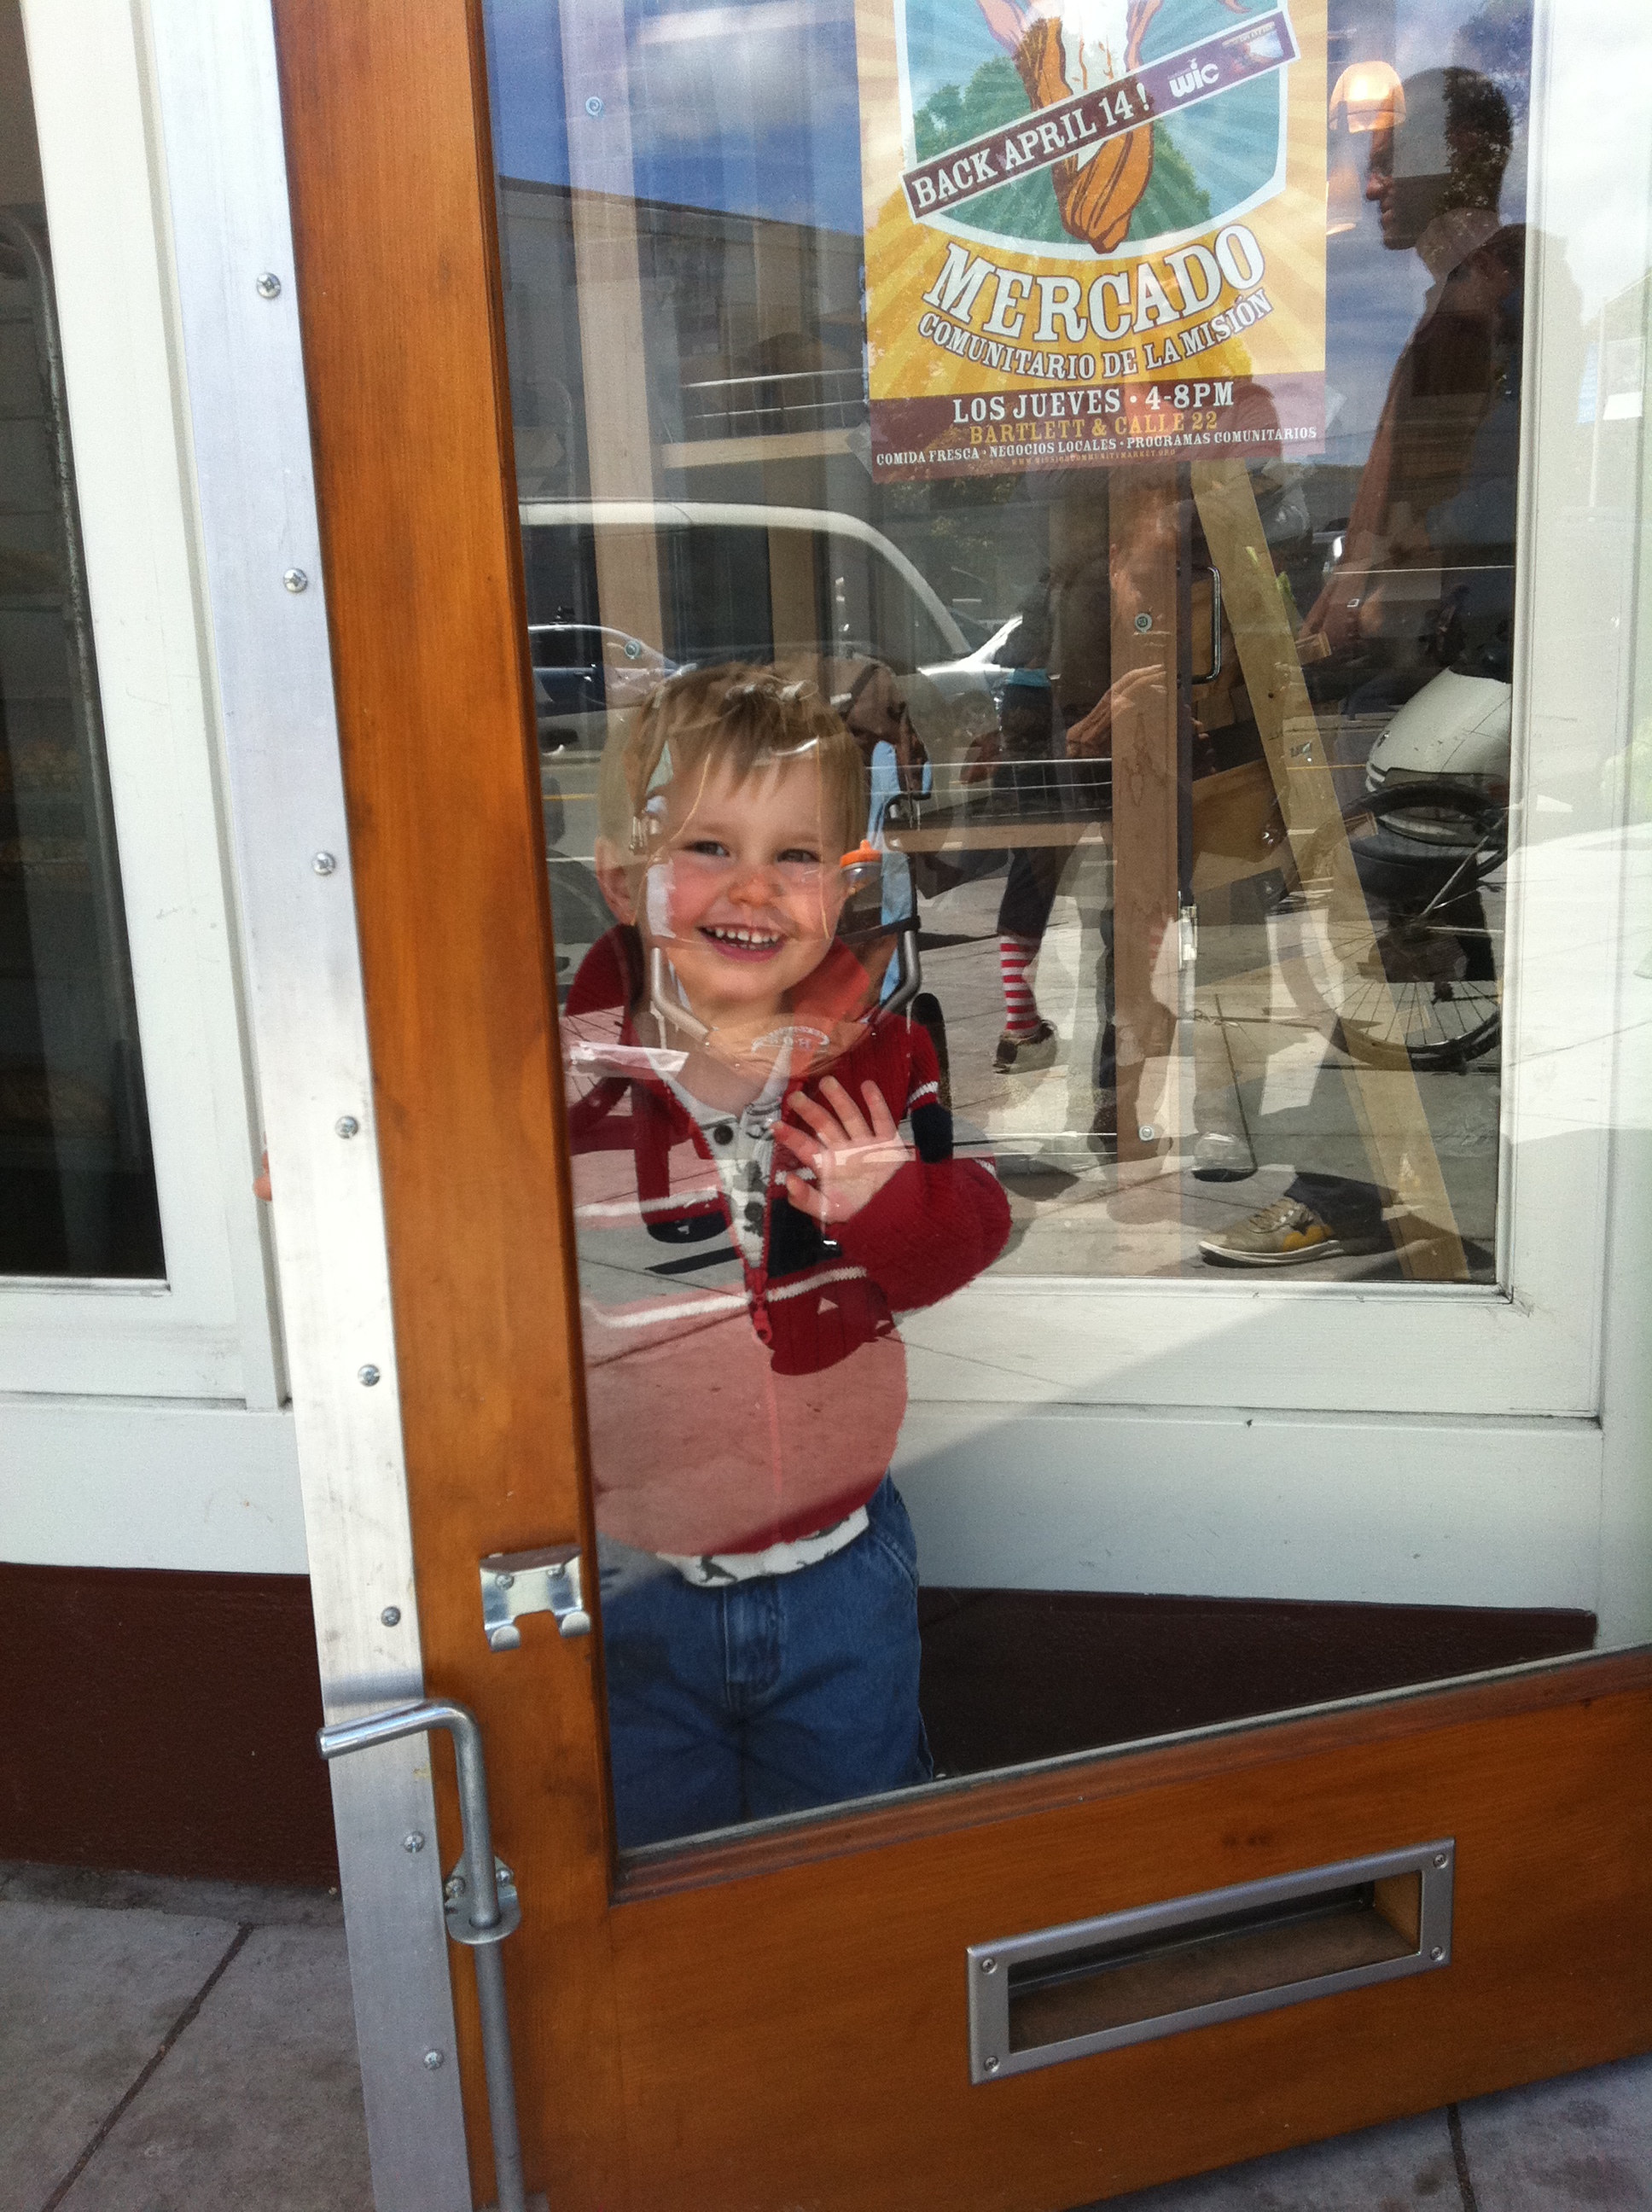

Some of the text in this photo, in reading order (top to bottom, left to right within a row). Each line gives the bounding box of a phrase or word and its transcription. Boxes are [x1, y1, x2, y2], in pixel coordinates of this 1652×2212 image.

[911, 151, 998, 208] BACK
[1002, 109, 1097, 170] APRIL
[922, 224, 1265, 342] MERCADO
[918, 288, 1274, 381] COMUNITARIO DE LA MISIÓN
[952, 381, 1235, 423] LOS JUEVES 4-8PM
[969, 410, 1218, 445] BARTLETT & CALLE 22
[876, 426, 1318, 466] COMIDA FRESCA NEGOCIOS LOCALES PROGRAMAS COMUNITARIOS
